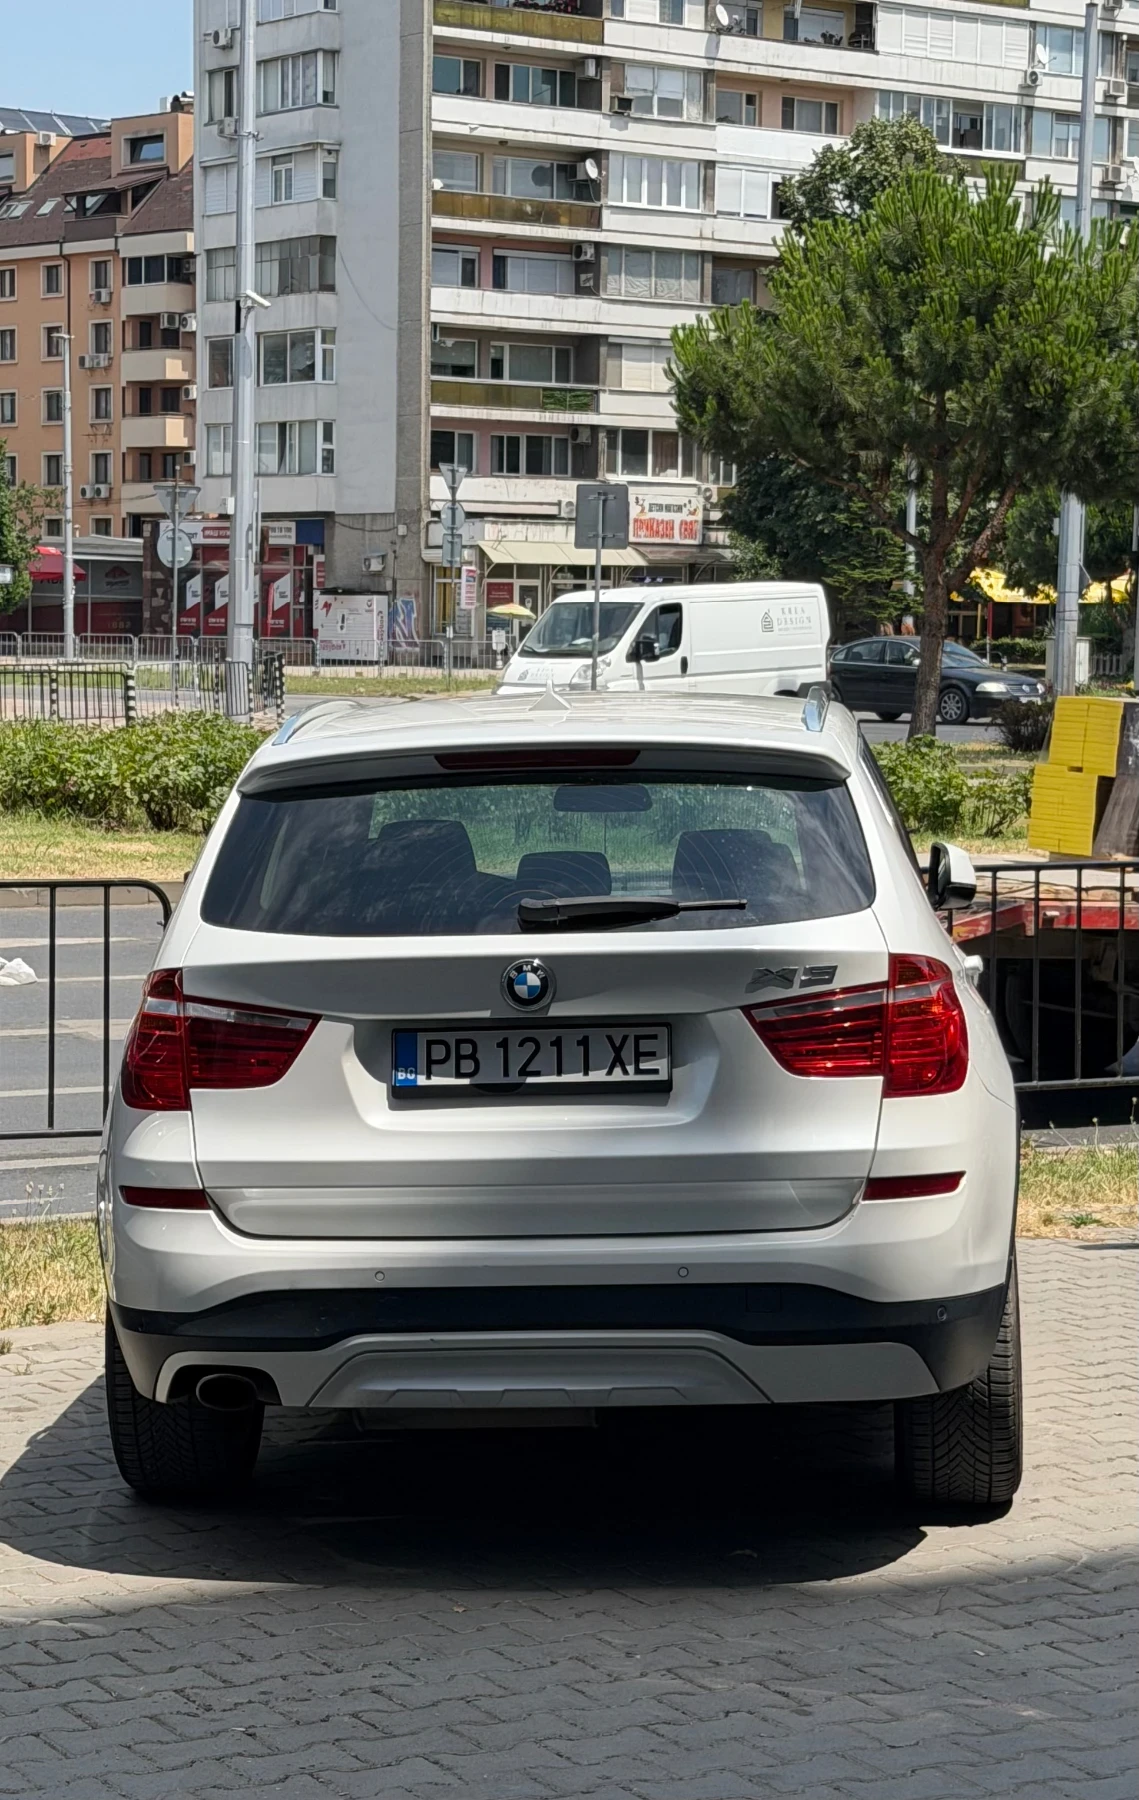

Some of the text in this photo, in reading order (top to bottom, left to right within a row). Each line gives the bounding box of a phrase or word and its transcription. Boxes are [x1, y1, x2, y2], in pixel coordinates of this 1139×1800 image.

[633, 517, 675, 540] ПРИКАЗЕН
[777, 616, 812, 626] DESIGN
[509, 964, 546, 980] BMW
[744, 964, 839, 994] X3
[425, 1033, 660, 1080] PB 1211 XE
[397, 1066, 416, 1080] BG
